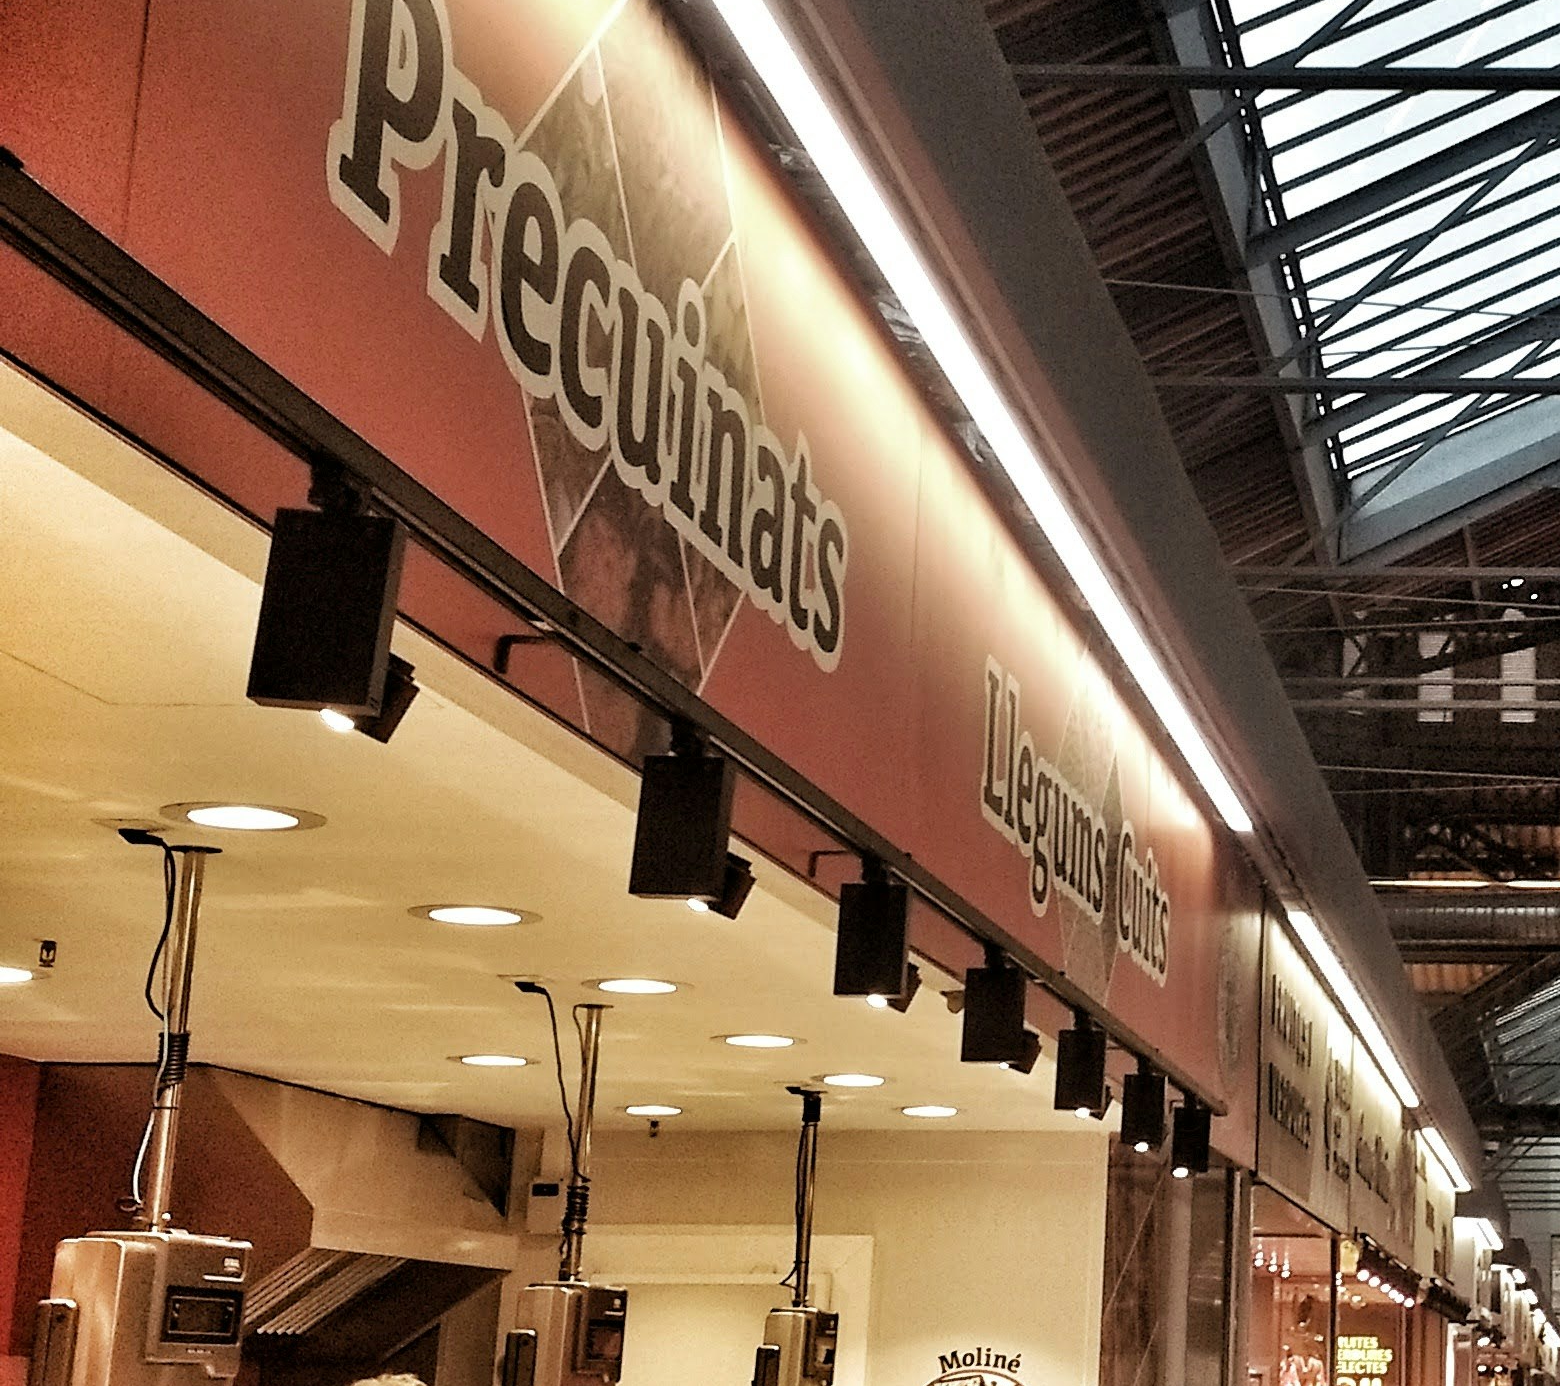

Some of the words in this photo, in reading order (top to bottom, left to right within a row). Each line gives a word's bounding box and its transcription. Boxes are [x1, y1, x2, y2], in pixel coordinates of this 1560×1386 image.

[983, 663, 1105, 918] Llegums
[1115, 827, 1169, 983] Cuits
[938, 1347, 1022, 1374] Moliné
[1337, 1348, 1393, 1361] ERDURES
[1336, 1361, 1388, 1374] ELECTES
